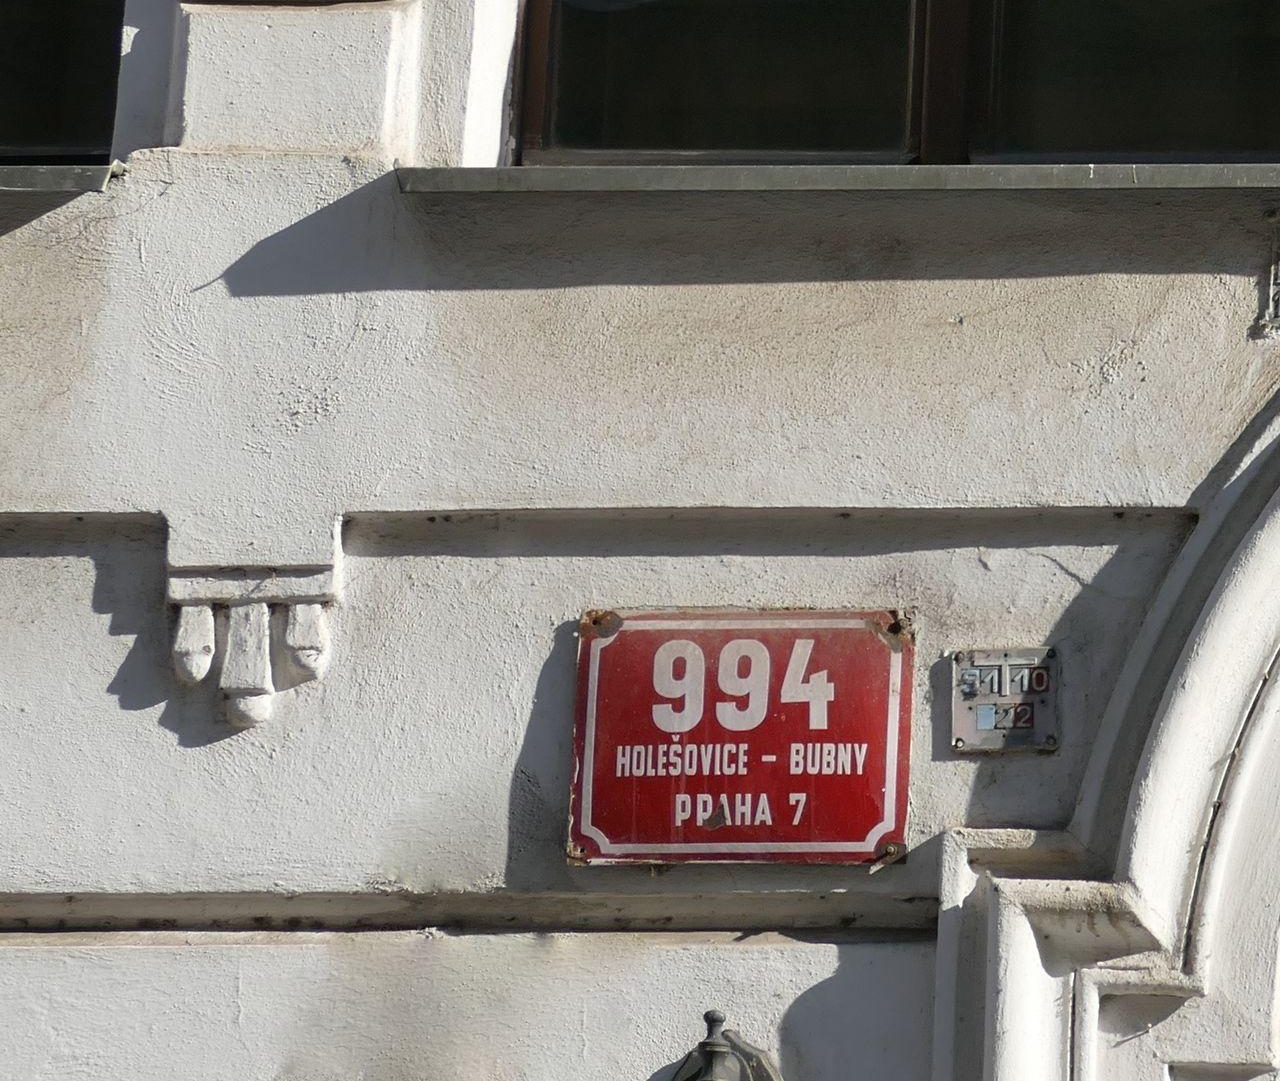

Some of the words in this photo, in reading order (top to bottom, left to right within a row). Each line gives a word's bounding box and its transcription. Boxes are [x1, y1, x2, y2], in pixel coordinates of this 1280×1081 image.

[653, 639, 834, 732] 994
[616, 734, 748, 777] HOLEŠOVICE
[789, 742, 869, 776] BUBNY
[675, 792, 773, 827] PRAHA
[788, 792, 807, 826] 7
